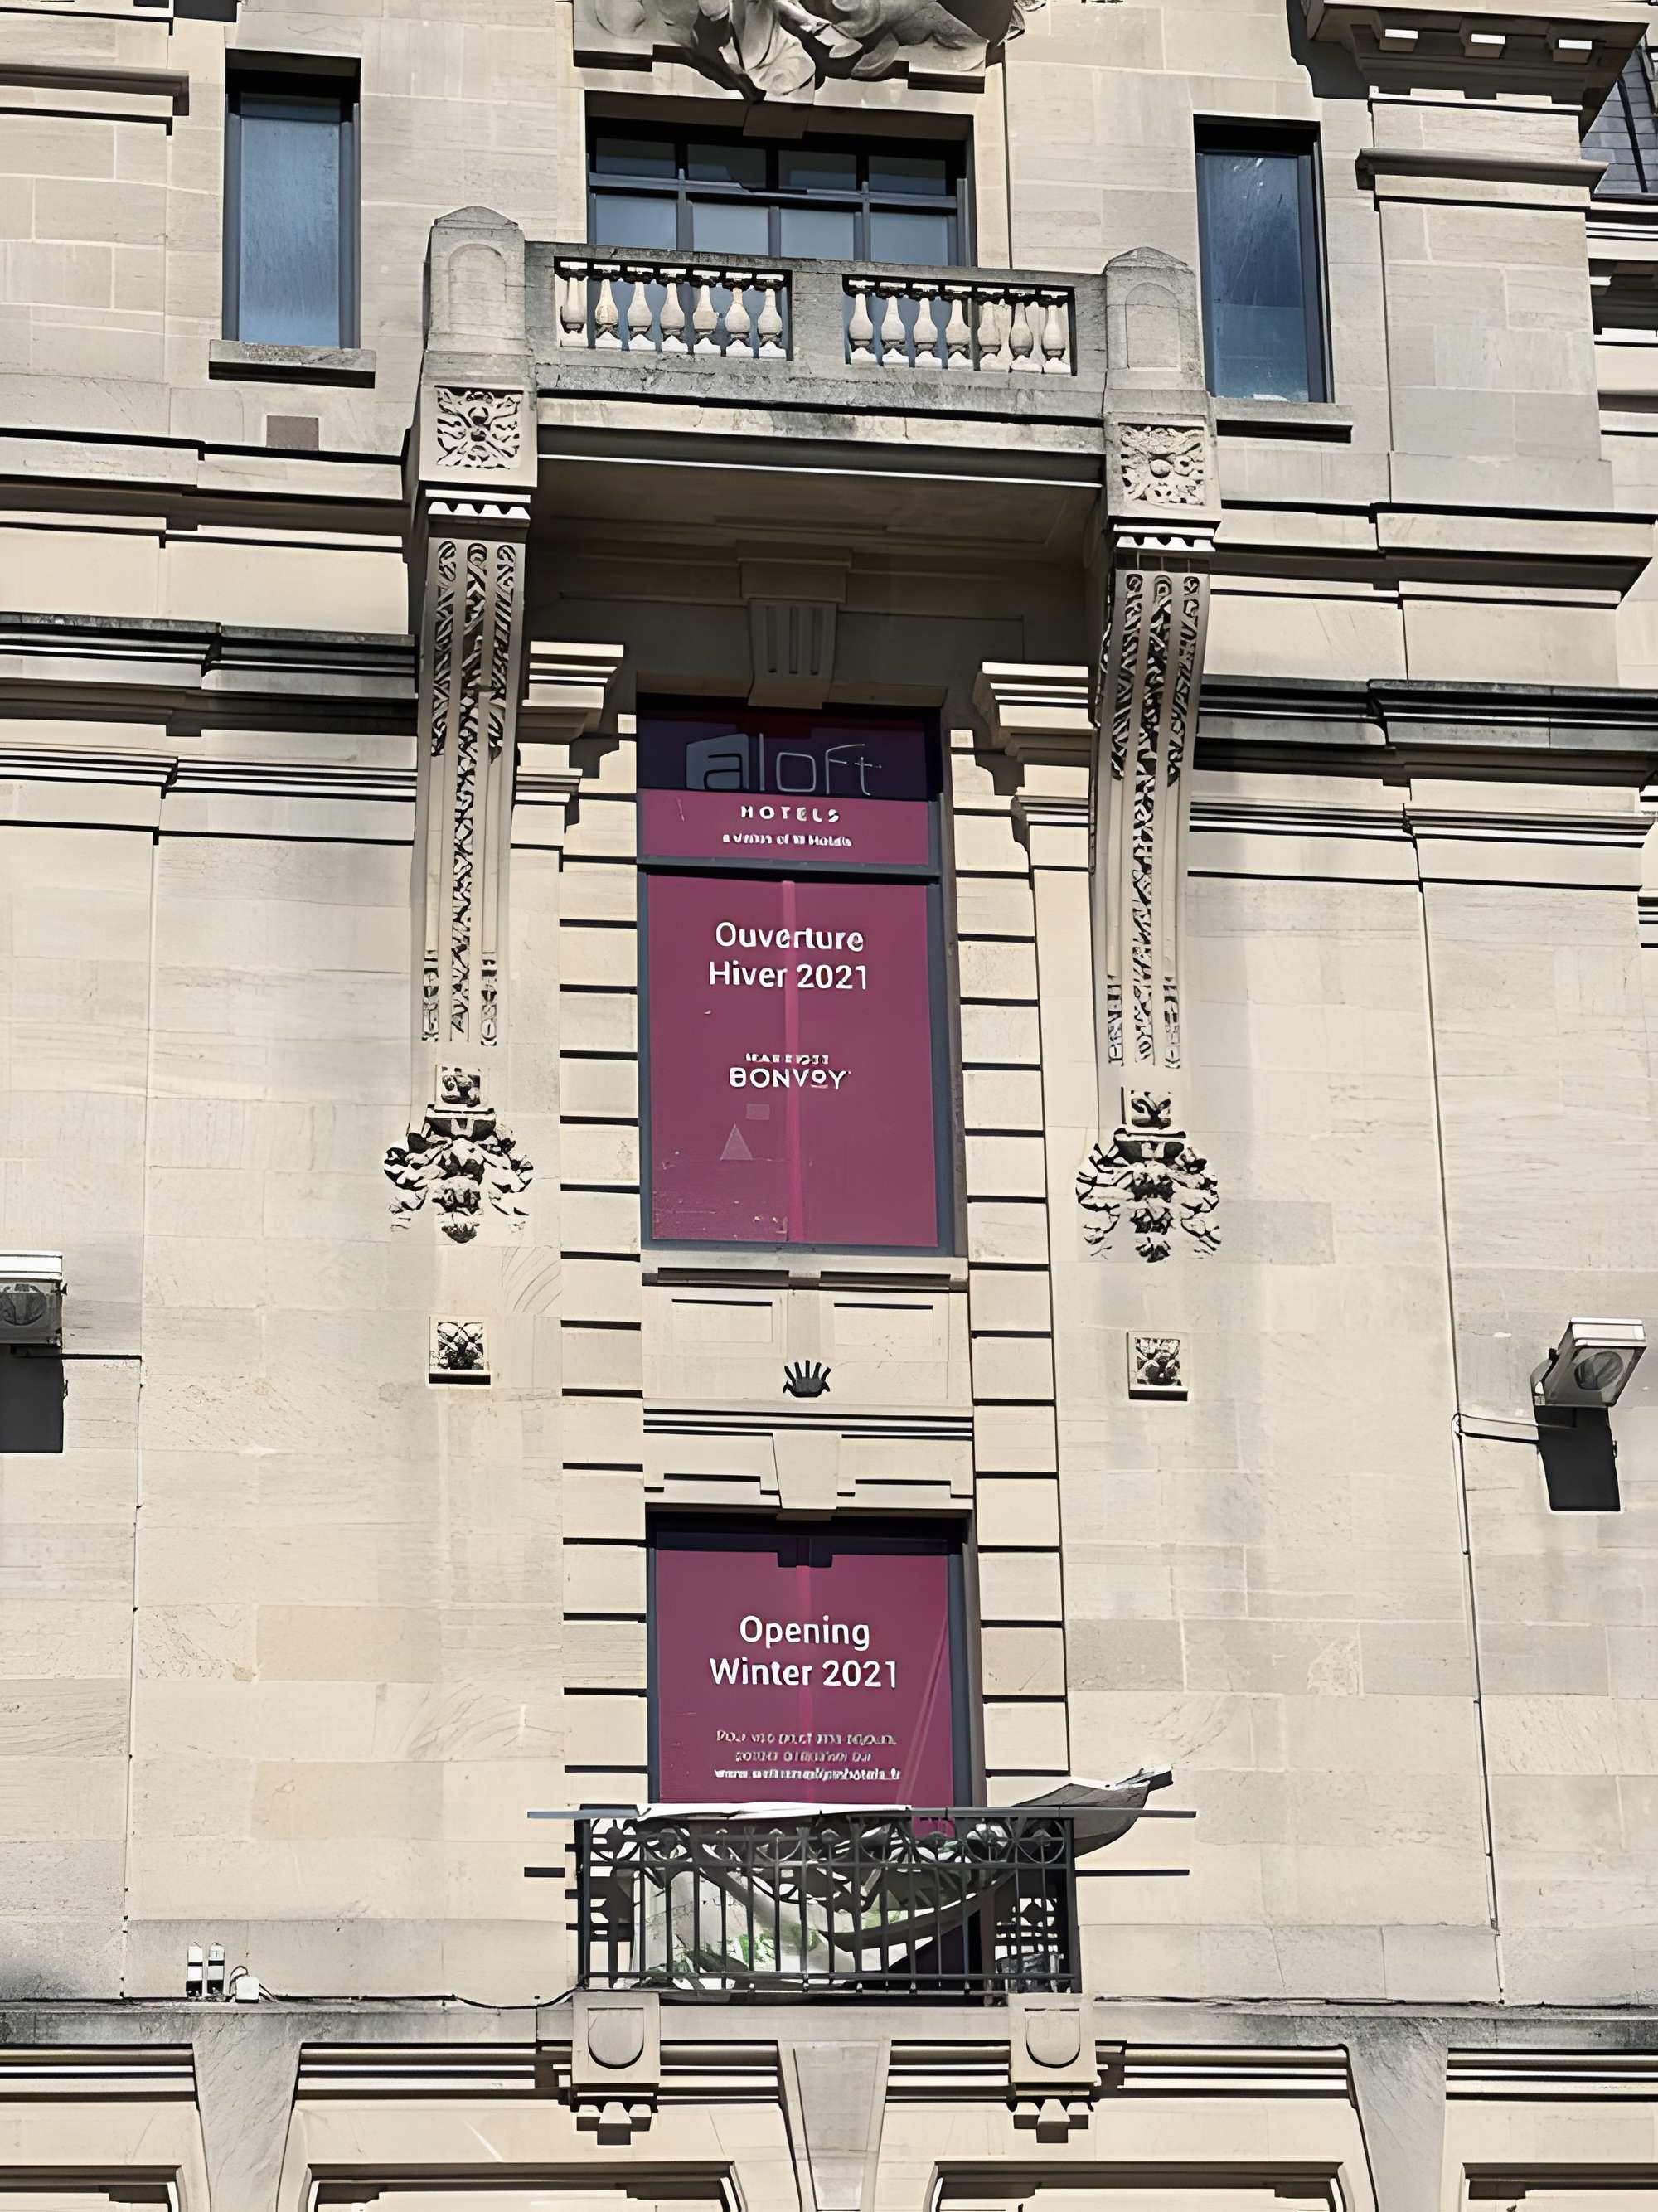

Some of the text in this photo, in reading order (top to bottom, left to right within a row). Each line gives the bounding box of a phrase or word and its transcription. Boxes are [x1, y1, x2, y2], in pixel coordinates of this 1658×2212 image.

[686, 733, 881, 796] aloft
[740, 805, 839, 822] HOTELS
[715, 921, 864, 953] Ouverture
[709, 959, 866, 990] Hiver 2021
[730, 1067, 846, 1090] BONVOY
[739, 1614, 870, 1652] Opening
[709, 1656, 895, 1688] Winter 2021
